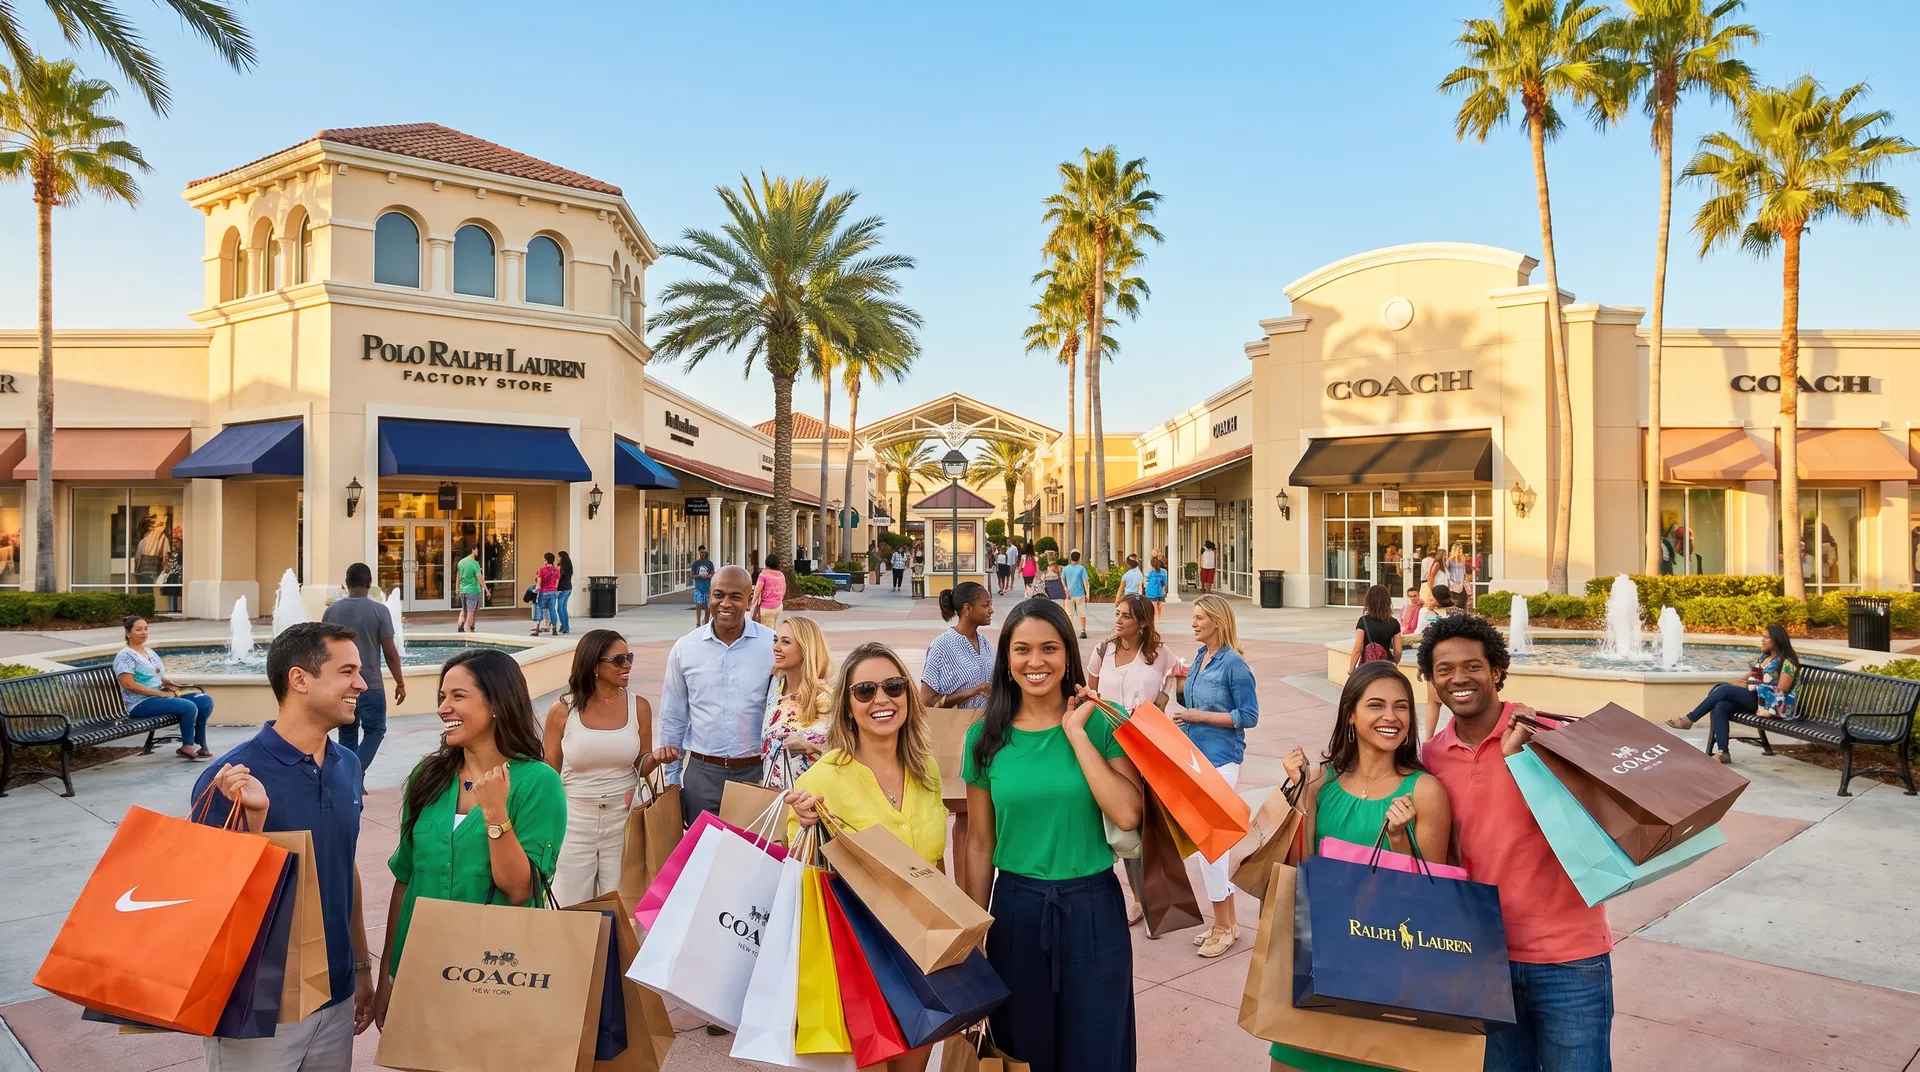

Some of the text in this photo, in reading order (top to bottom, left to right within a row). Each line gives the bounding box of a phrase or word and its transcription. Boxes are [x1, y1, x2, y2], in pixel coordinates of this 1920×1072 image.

[361, 333, 587, 379] POLO RALPH LAUREN
[0, 374, 19, 394] R
[403, 370, 553, 393] FACTORY STORE
[1326, 369, 1475, 401] COACH
[1730, 374, 1872, 393] COACH
[1612, 743, 1670, 774] COACH
[718, 911, 761, 947] COA
[1348, 918, 1473, 954] RALPH LAUREN
[737, 942, 752, 953] NEW
[442, 965, 552, 989] COACH
[491, 988, 512, 996] YORK
